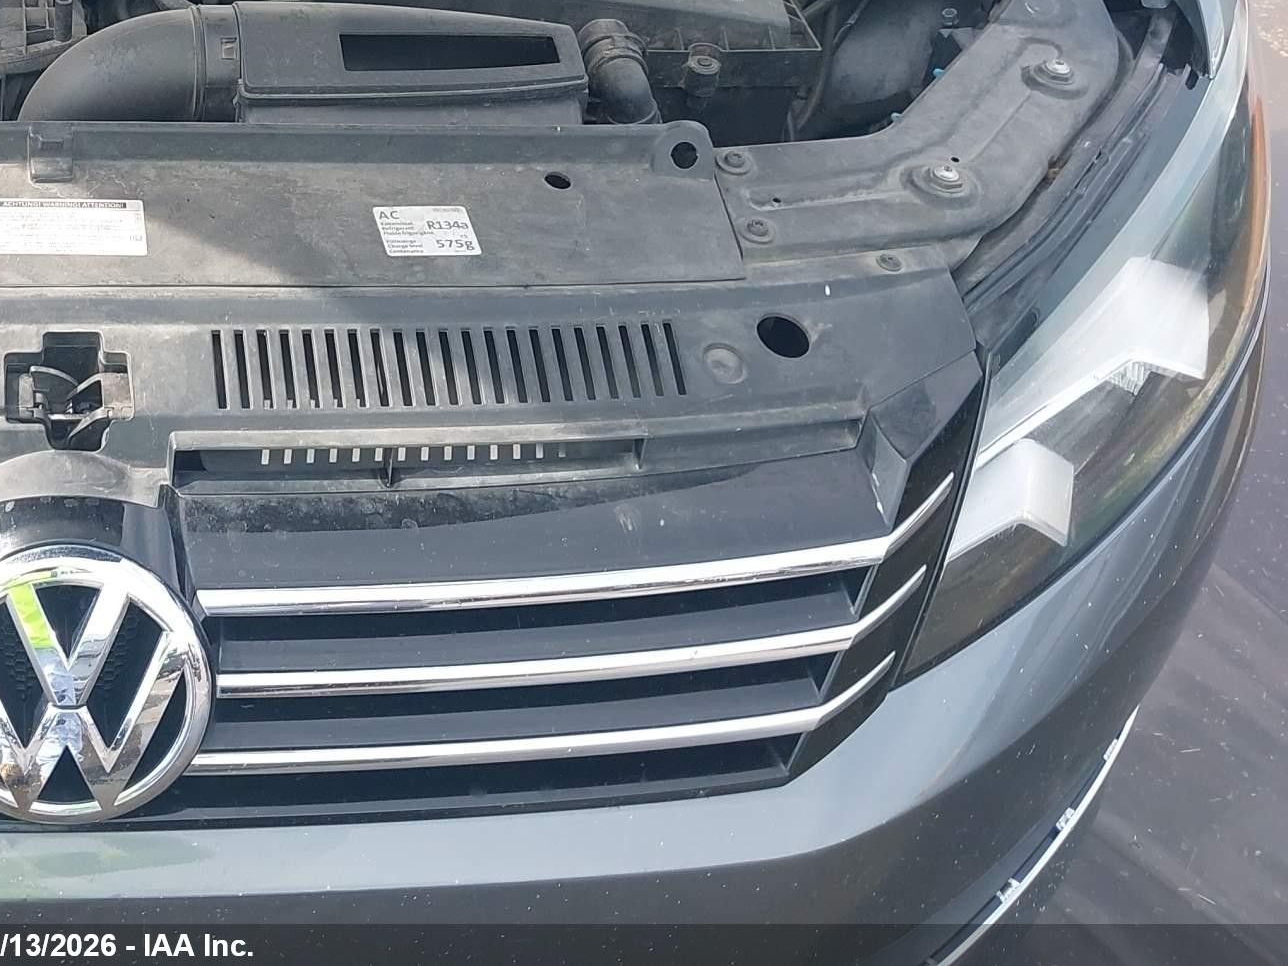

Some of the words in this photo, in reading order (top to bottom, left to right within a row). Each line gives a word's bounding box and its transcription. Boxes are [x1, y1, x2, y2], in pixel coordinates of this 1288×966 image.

[379, 210, 400, 220] AC
[426, 220, 469, 230] R134a
[435, 239, 475, 251] 575g
